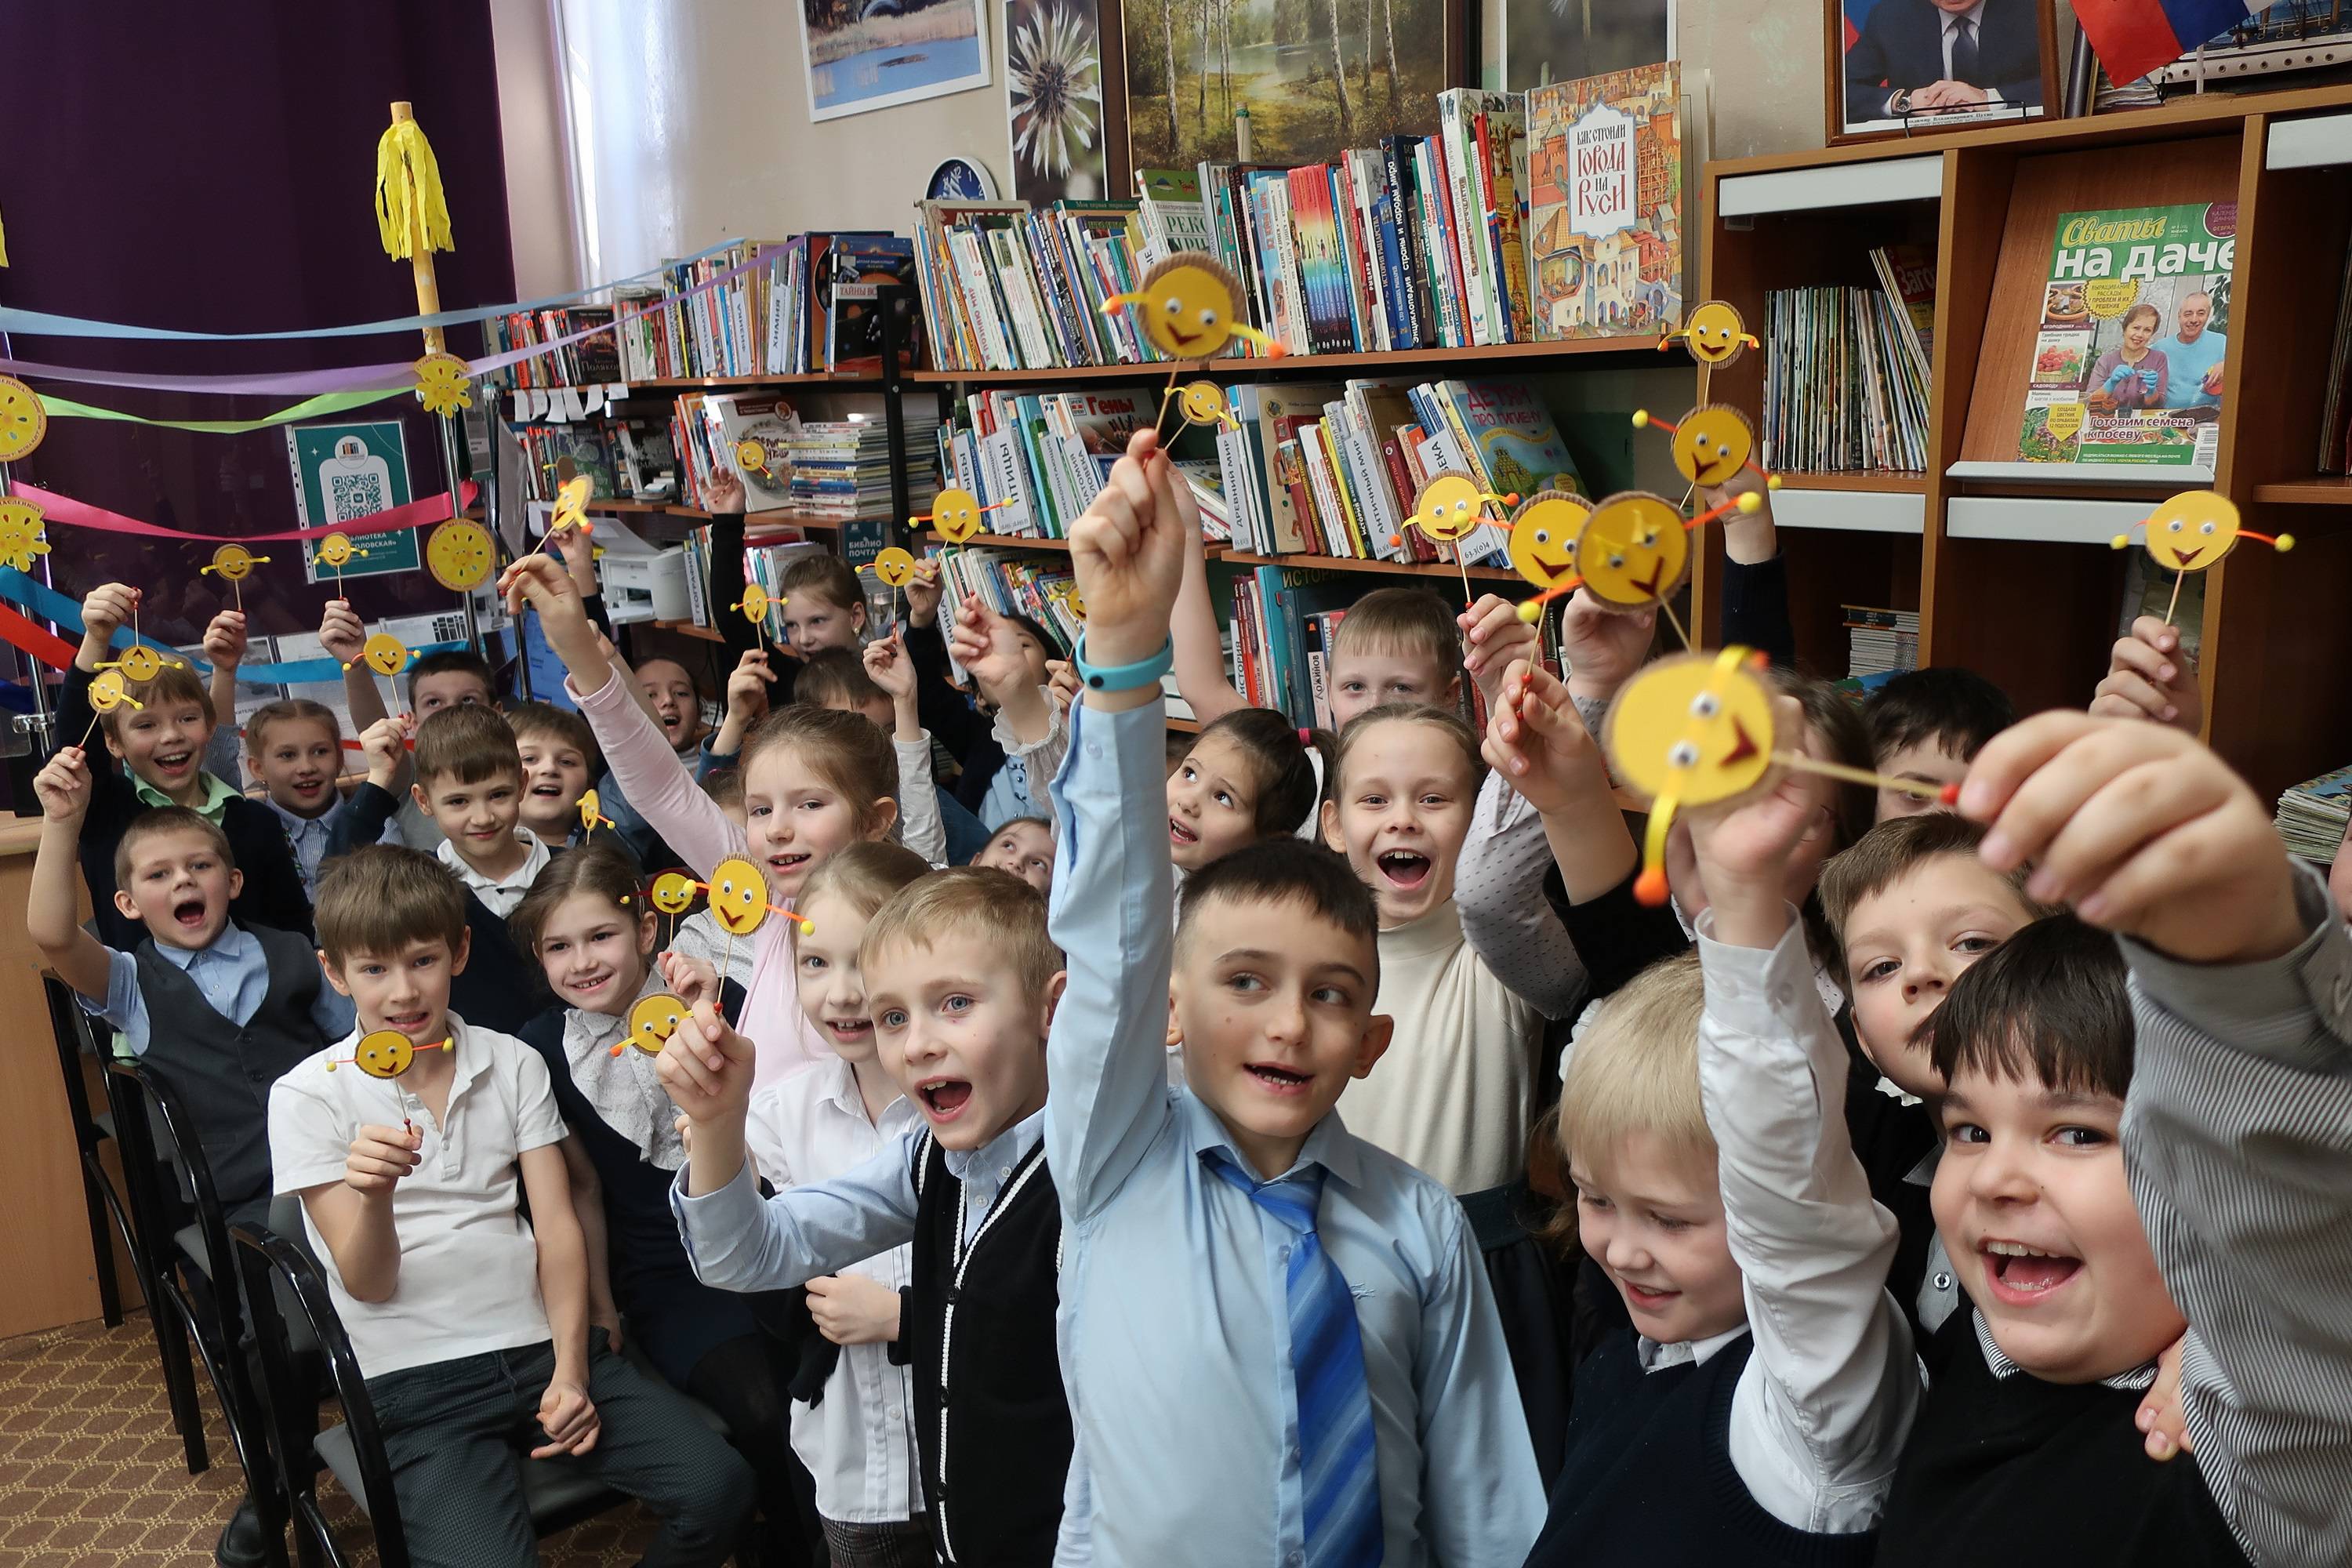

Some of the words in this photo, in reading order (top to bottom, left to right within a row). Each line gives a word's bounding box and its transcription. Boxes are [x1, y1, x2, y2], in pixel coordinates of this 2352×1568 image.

[1577, 131, 1592, 145] КАК
[1592, 124, 1626, 142] СТРОИЛИ
[1577, 142, 1625, 177] ГОРОДА
[1578, 174, 1626, 216] РУСИ
[1595, 176, 1608, 191] НА
[1372, 215, 1384, 255] РЫЦАРСТВА
[2062, 216, 2167, 248] Сваты
[1378, 254, 1388, 287] ИСТОРИЯ
[1400, 241, 1410, 270] страны
[2055, 247, 2112, 278] на
[2120, 238, 2234, 283] даче
[840, 286, 865, 296] ТАЙНЫ
[1364, 261, 1375, 290] РЫЦАРИ
[698, 294, 710, 358] МАТЕМАТИКА
[1406, 276, 1420, 343] Энциклопедия
[667, 305, 679, 361] ЭКОЛОГИЯ
[736, 303, 746, 351] ФИЗИКА
[583, 361, 619, 371] Поляко
[1086, 396, 1135, 416] Гены
[1472, 413, 1496, 426] ПРО
[1497, 409, 1542, 424] ГИГИЕНУ
[2089, 417, 2144, 427] Готовим
[2147, 417, 2194, 427] семена
[1454, 425, 1479, 466] ГИГИЕНУ
[2088, 430, 2096, 439] к
[2097, 430, 2142, 441] посеву
[1224, 439, 1233, 467] МИР
[1323, 452, 1334, 480] СВЕТА
[1353, 439, 1366, 466] МИР
[960, 453, 971, 491] ЫБЫ
[986, 440, 1004, 517] ПРСМЫКАЮЩИЕСЯ
[1000, 443, 1019, 503] ПТИЦЫ
[1047, 440, 1069, 518] МЛЕКОПИТАЮЩИЕ
[1070, 454, 1091, 506] НАТОМИЯ
[1079, 449, 1098, 498] ЕЛОВЕКА
[1389, 460, 1403, 486] АНГЛИИ
[1474, 466, 1489, 486] ПРО
[1229, 470, 1243, 528] ДРЕВНИЙ
[1363, 468, 1385, 534] АНТИЧНЫЙ
[1397, 487, 1412, 517] ИСТОРИЯ
[1355, 501, 1367, 535] ИСТОРИЯ
[849, 540, 881, 549] БИБЛИО
[849, 549, 876, 557] ПОЧТА
[1465, 541, 1490, 559] 63.3(0)4
[688, 554, 700, 614] ГЕОГРАФИЯ
[1235, 641, 1246, 694] ИСТОРИЯ
